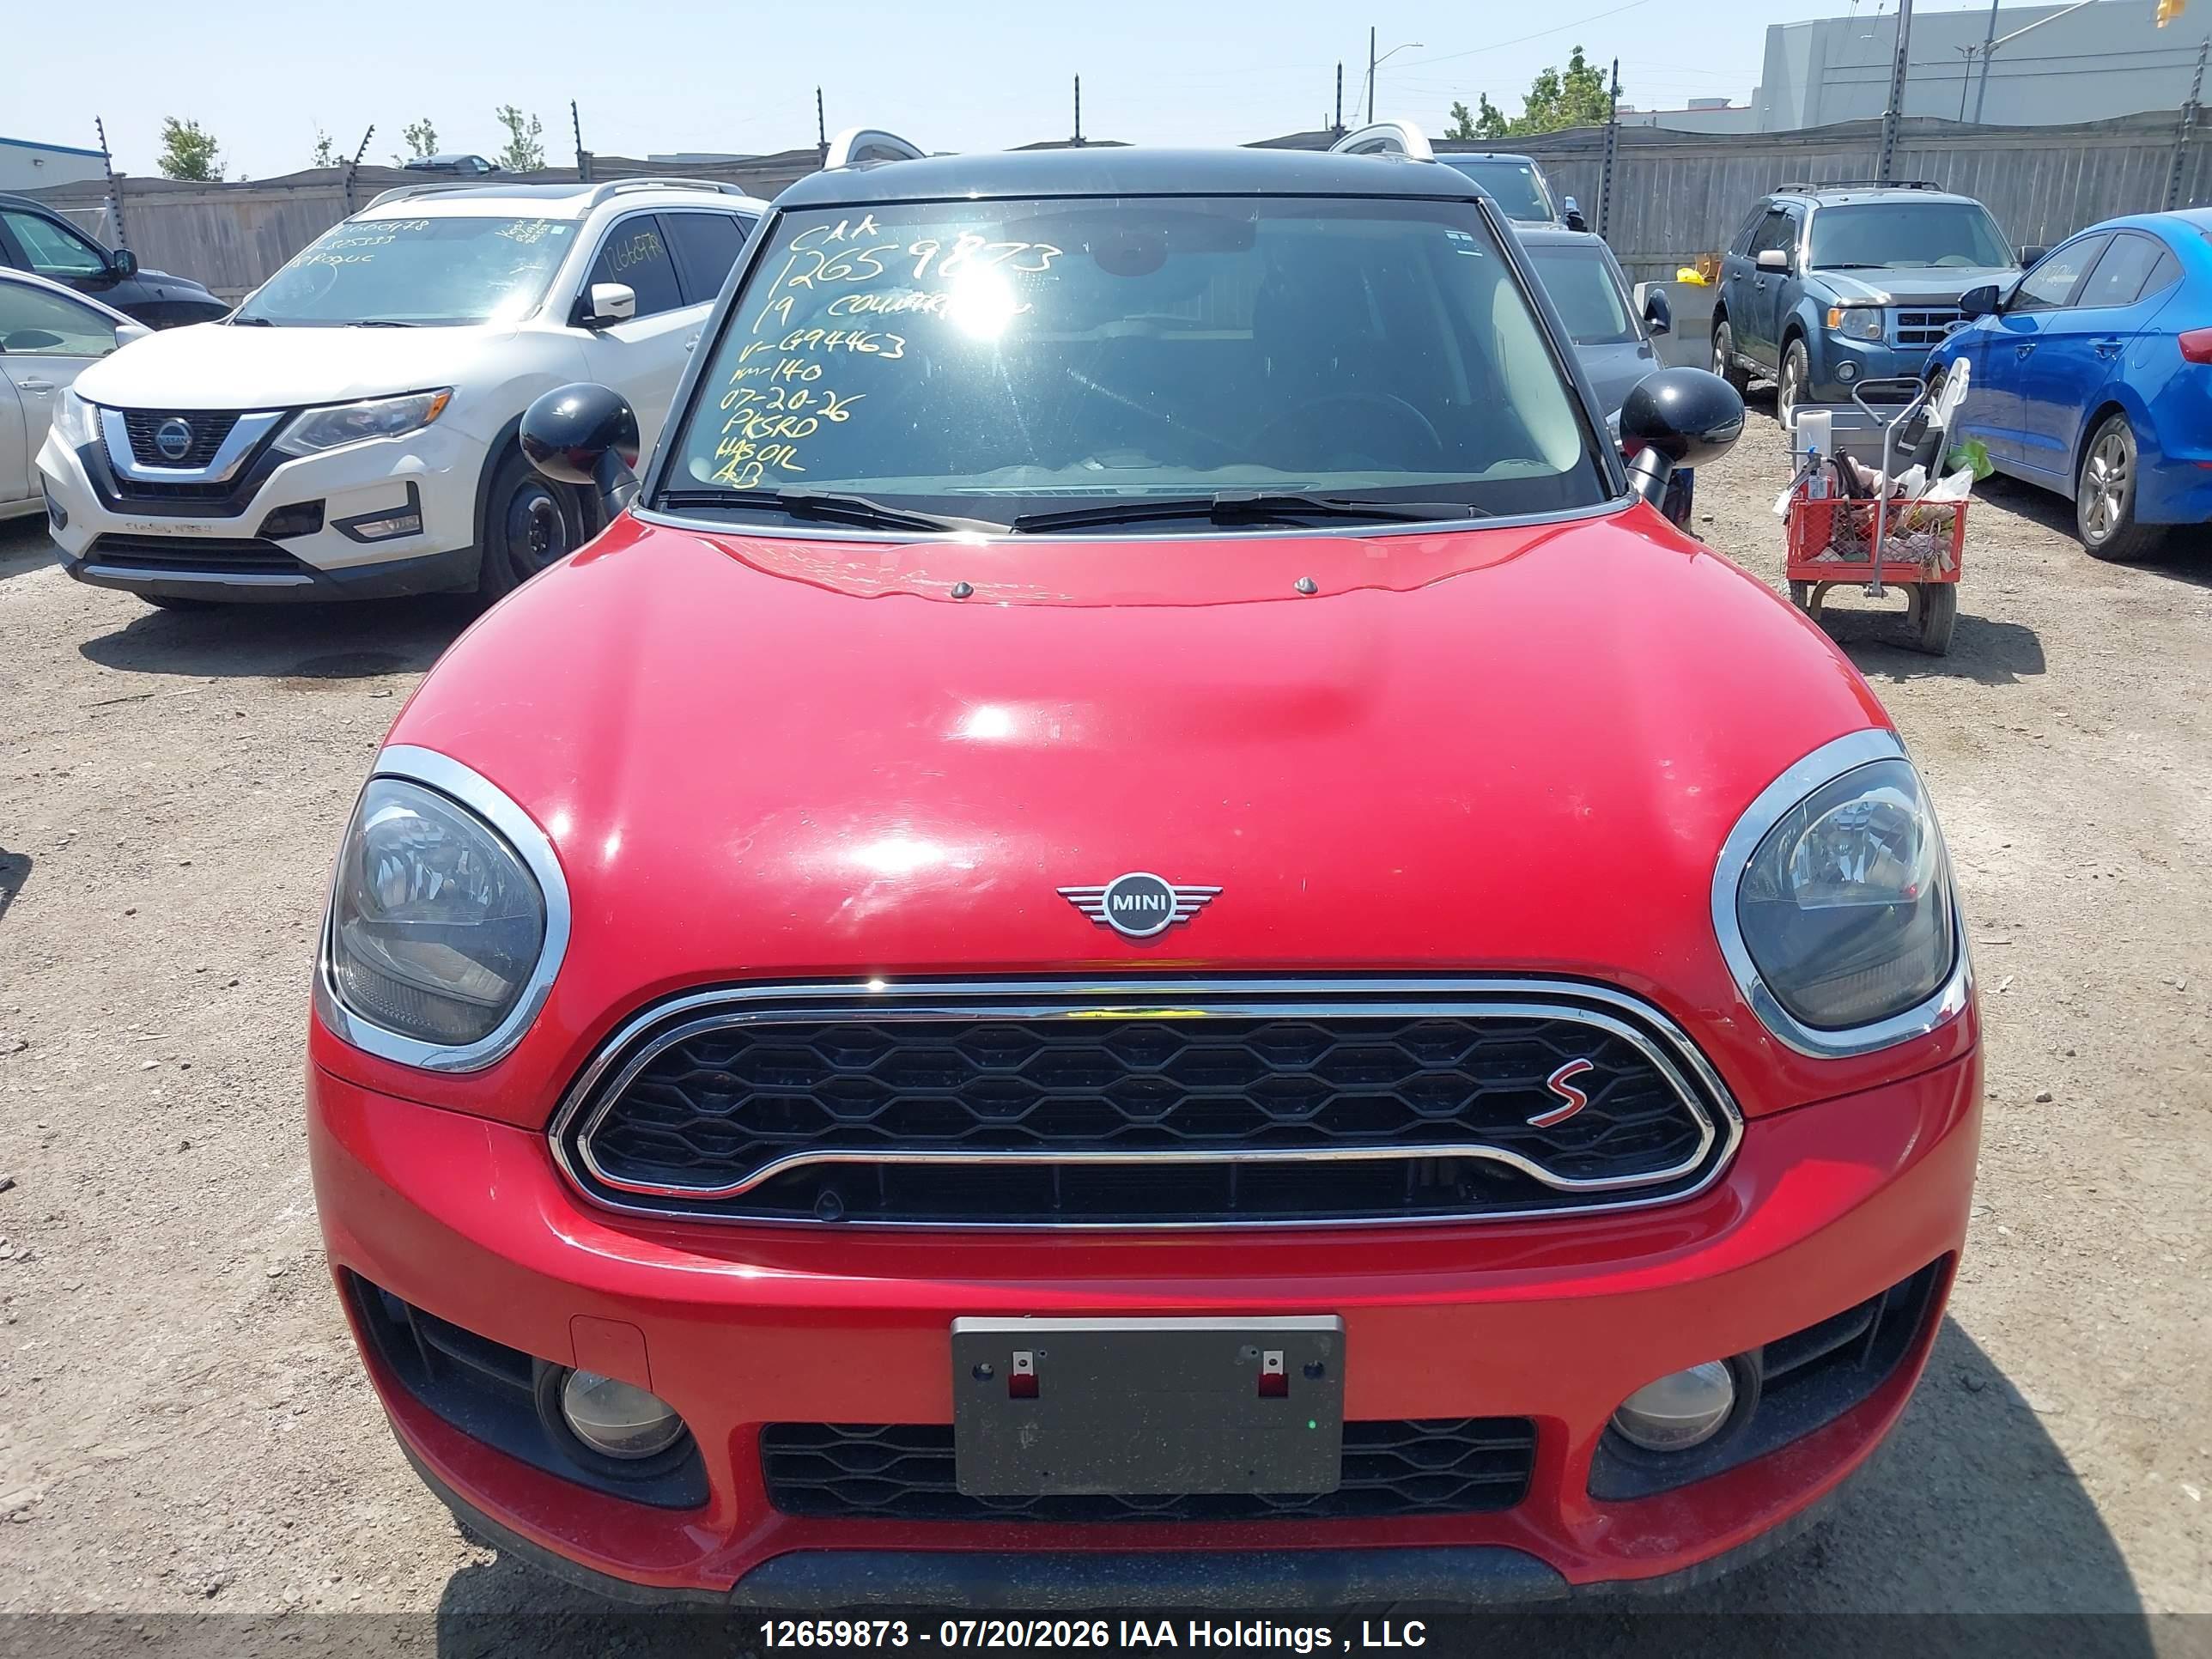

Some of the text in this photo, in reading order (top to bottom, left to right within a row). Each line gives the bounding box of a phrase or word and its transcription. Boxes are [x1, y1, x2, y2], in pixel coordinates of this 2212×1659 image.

[752, 296, 796, 335] 19
[720, 386, 867, 422] 07-20-26
[158, 434, 188, 445] NISSAN
[714, 436, 806, 471] HAS OIL
[1113, 894, 1166, 911] MINI
[1526, 1057, 1595, 1128] S
